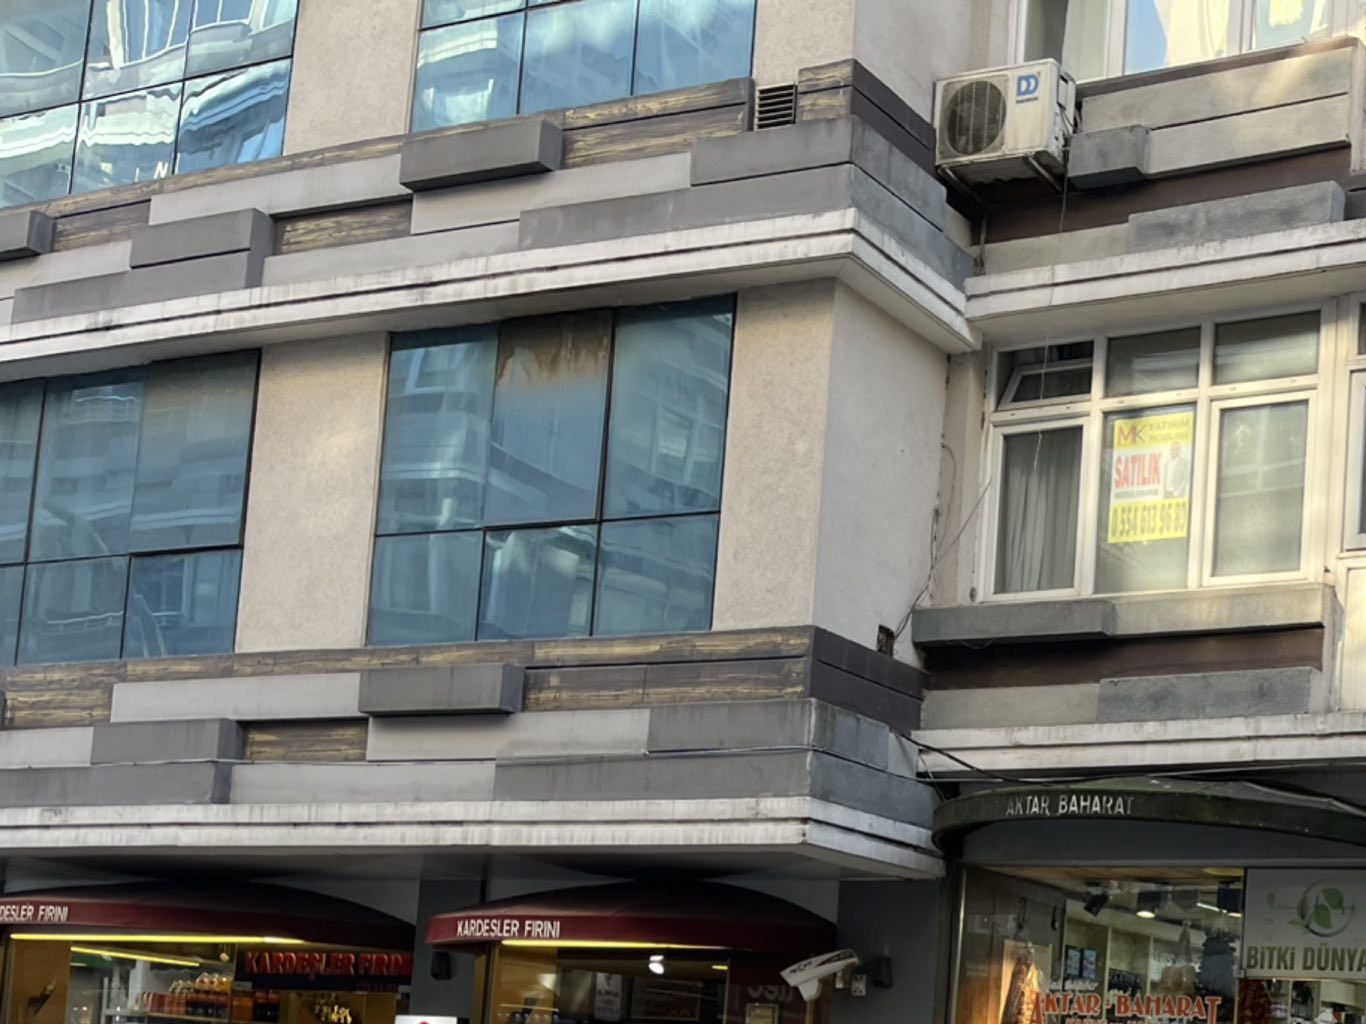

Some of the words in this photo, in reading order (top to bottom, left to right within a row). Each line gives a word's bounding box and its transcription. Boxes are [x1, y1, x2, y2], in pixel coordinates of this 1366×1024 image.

[1114, 451, 1162, 489] SATILIK
[1005, 795, 1051, 816] AKTAR
[1057, 794, 1135, 816] BAHARAT
[524, 919, 561, 939] FIRINI
